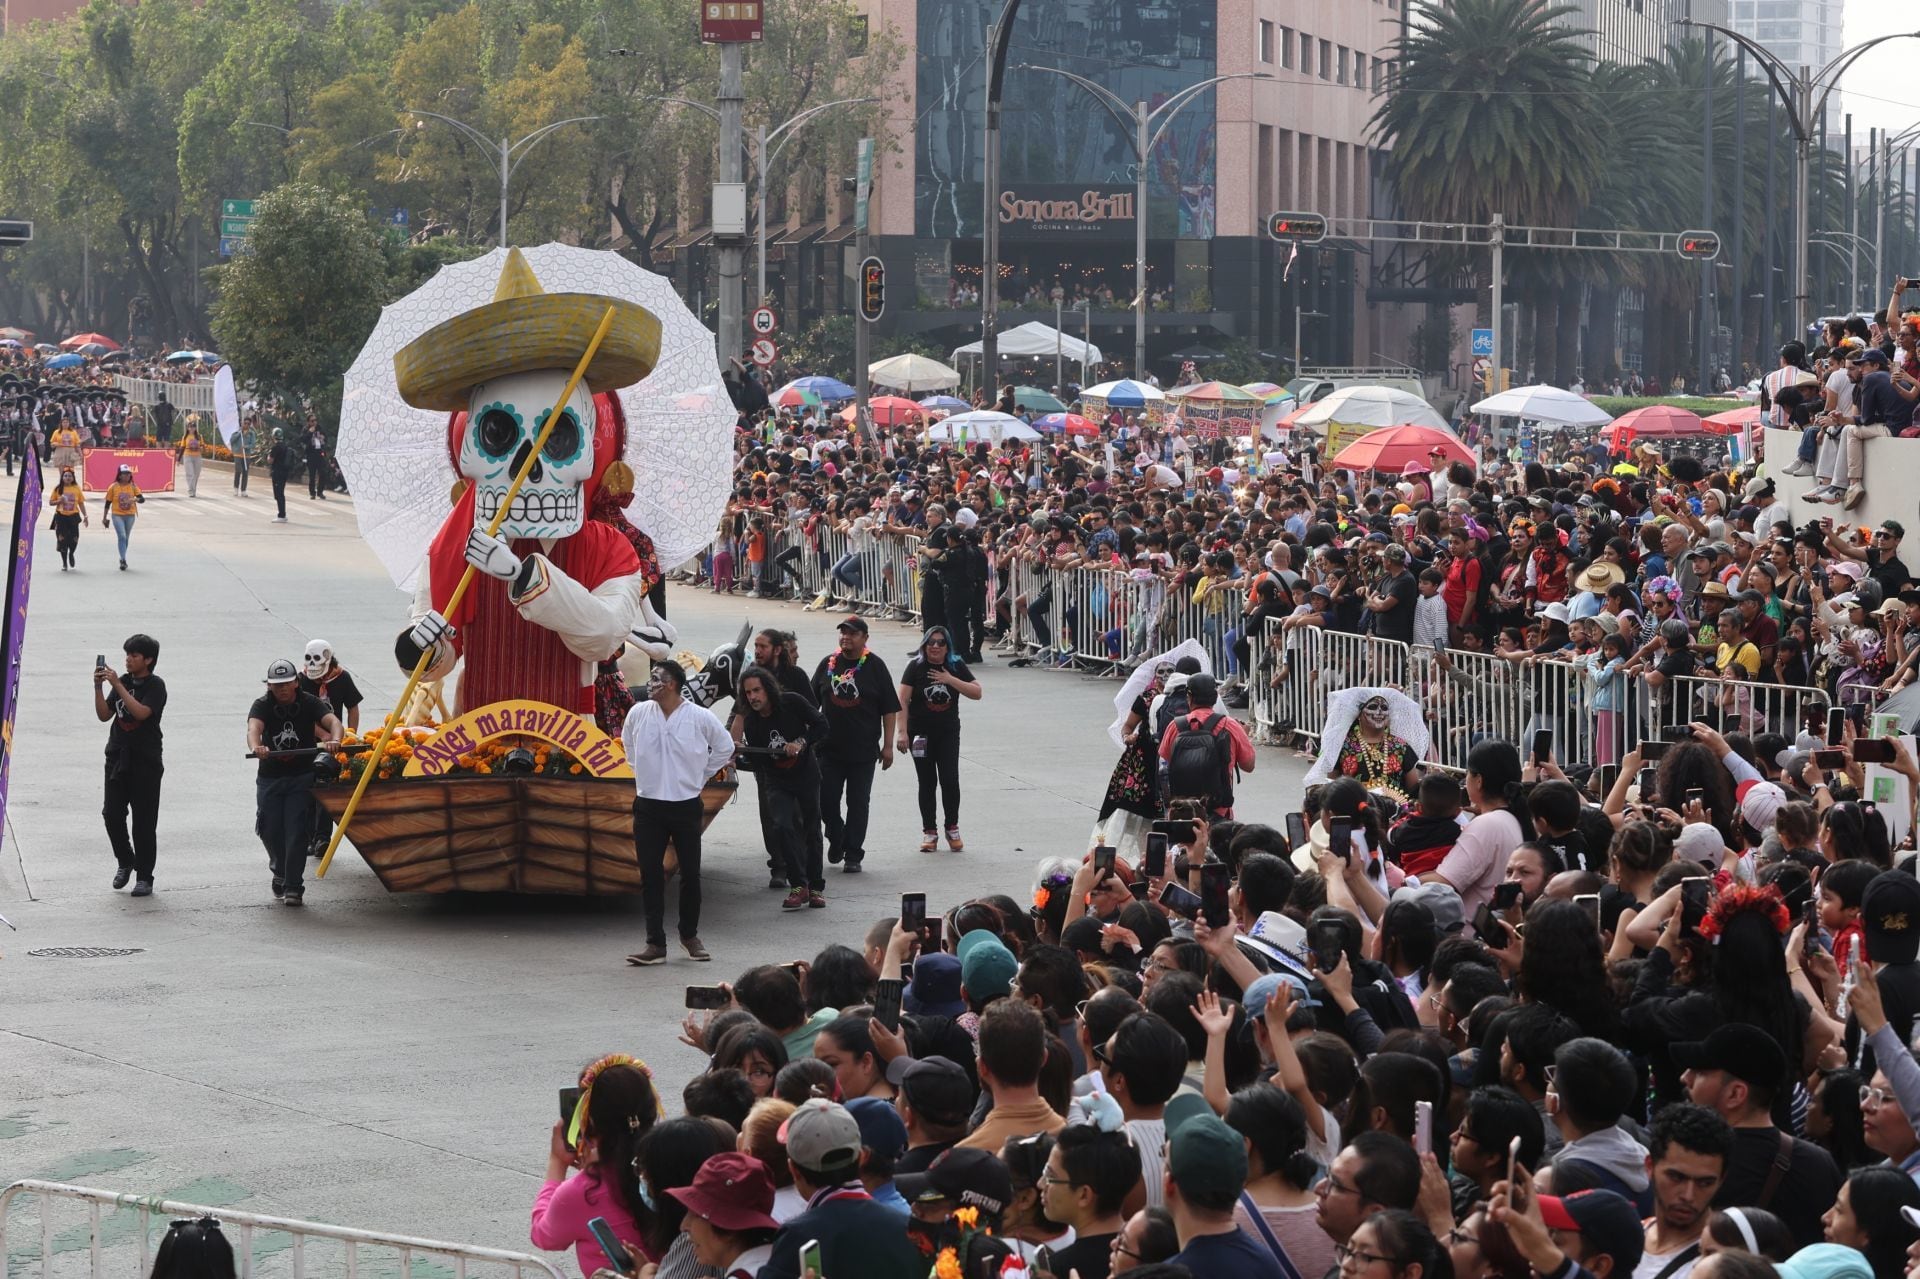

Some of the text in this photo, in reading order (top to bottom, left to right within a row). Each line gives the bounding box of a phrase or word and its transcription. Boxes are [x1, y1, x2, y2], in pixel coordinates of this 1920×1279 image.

[999, 190, 1079, 222] Sonora
[413, 708, 626, 776] Ayer maravilla fui
